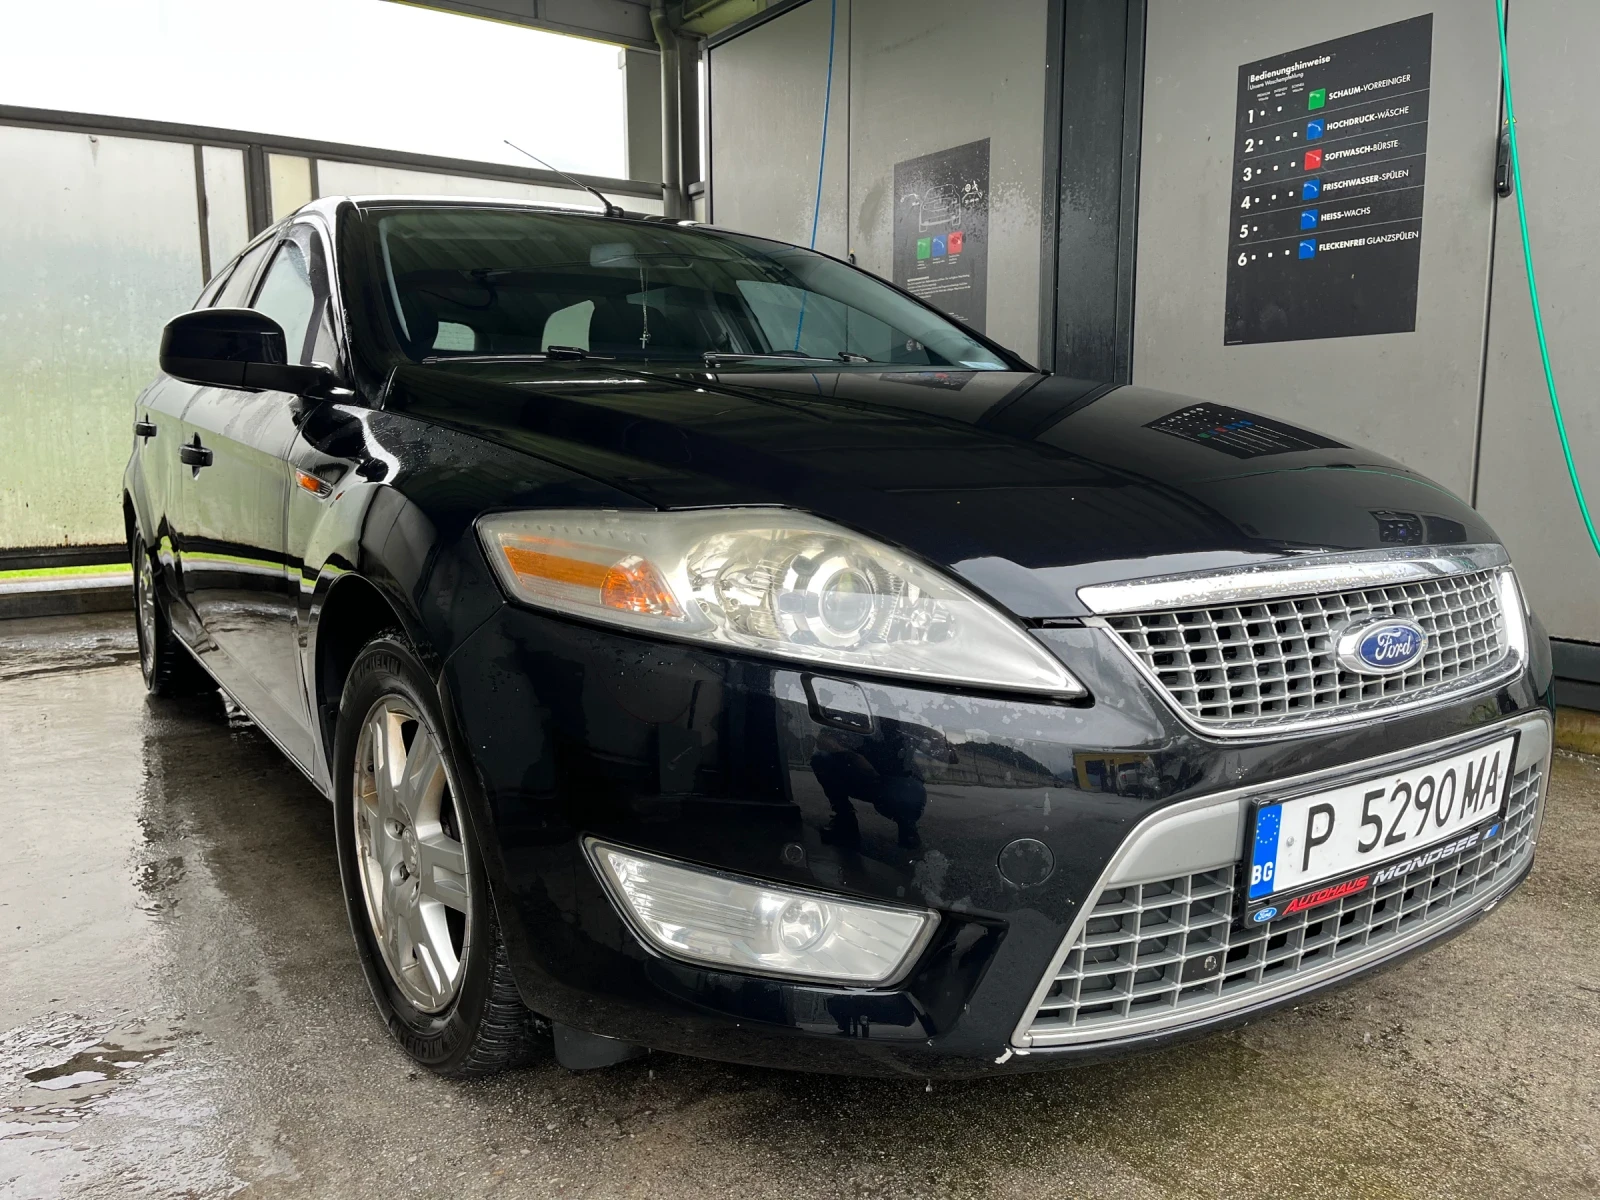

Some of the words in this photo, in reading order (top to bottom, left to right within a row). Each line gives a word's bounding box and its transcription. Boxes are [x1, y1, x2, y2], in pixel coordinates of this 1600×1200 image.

[1249, 82, 1265, 91] Unsere
[1250, 55, 1331, 83] Bedienungshinweise
[1247, 109, 1255, 123] 1
[1328, 74, 1411, 101] SCHAUM-VORREINIGER
[1244, 138, 1254, 153] 2
[1326, 105, 1410, 131] HOCHDRUCK-WÄSCHE
[1242, 167, 1252, 181] 3
[1324, 139, 1399, 162] SOFTWASCH-BÜRSTE
[1240, 195, 1251, 210] 4
[1322, 169, 1409, 192] FRISCHWASSER-SPÜLEN
[1239, 224, 1249, 238] 5
[1320, 206, 1371, 222] HEISS-WACHS
[1237, 252, 1247, 267] 6
[1319, 238, 1366, 252] FLECKENFREI
[1366, 230, 1419, 245] GLANZSPÜLEN
[1375, 631, 1413, 661] Ford
[1301, 803, 1336, 872] P
[1357, 768, 1457, 853] 5290
[1459, 751, 1501, 820] MA
[1251, 861, 1274, 885] BG
[1282, 875, 1370, 915] AUTOHAUS
[1372, 832, 1480, 885] MONDSEE
